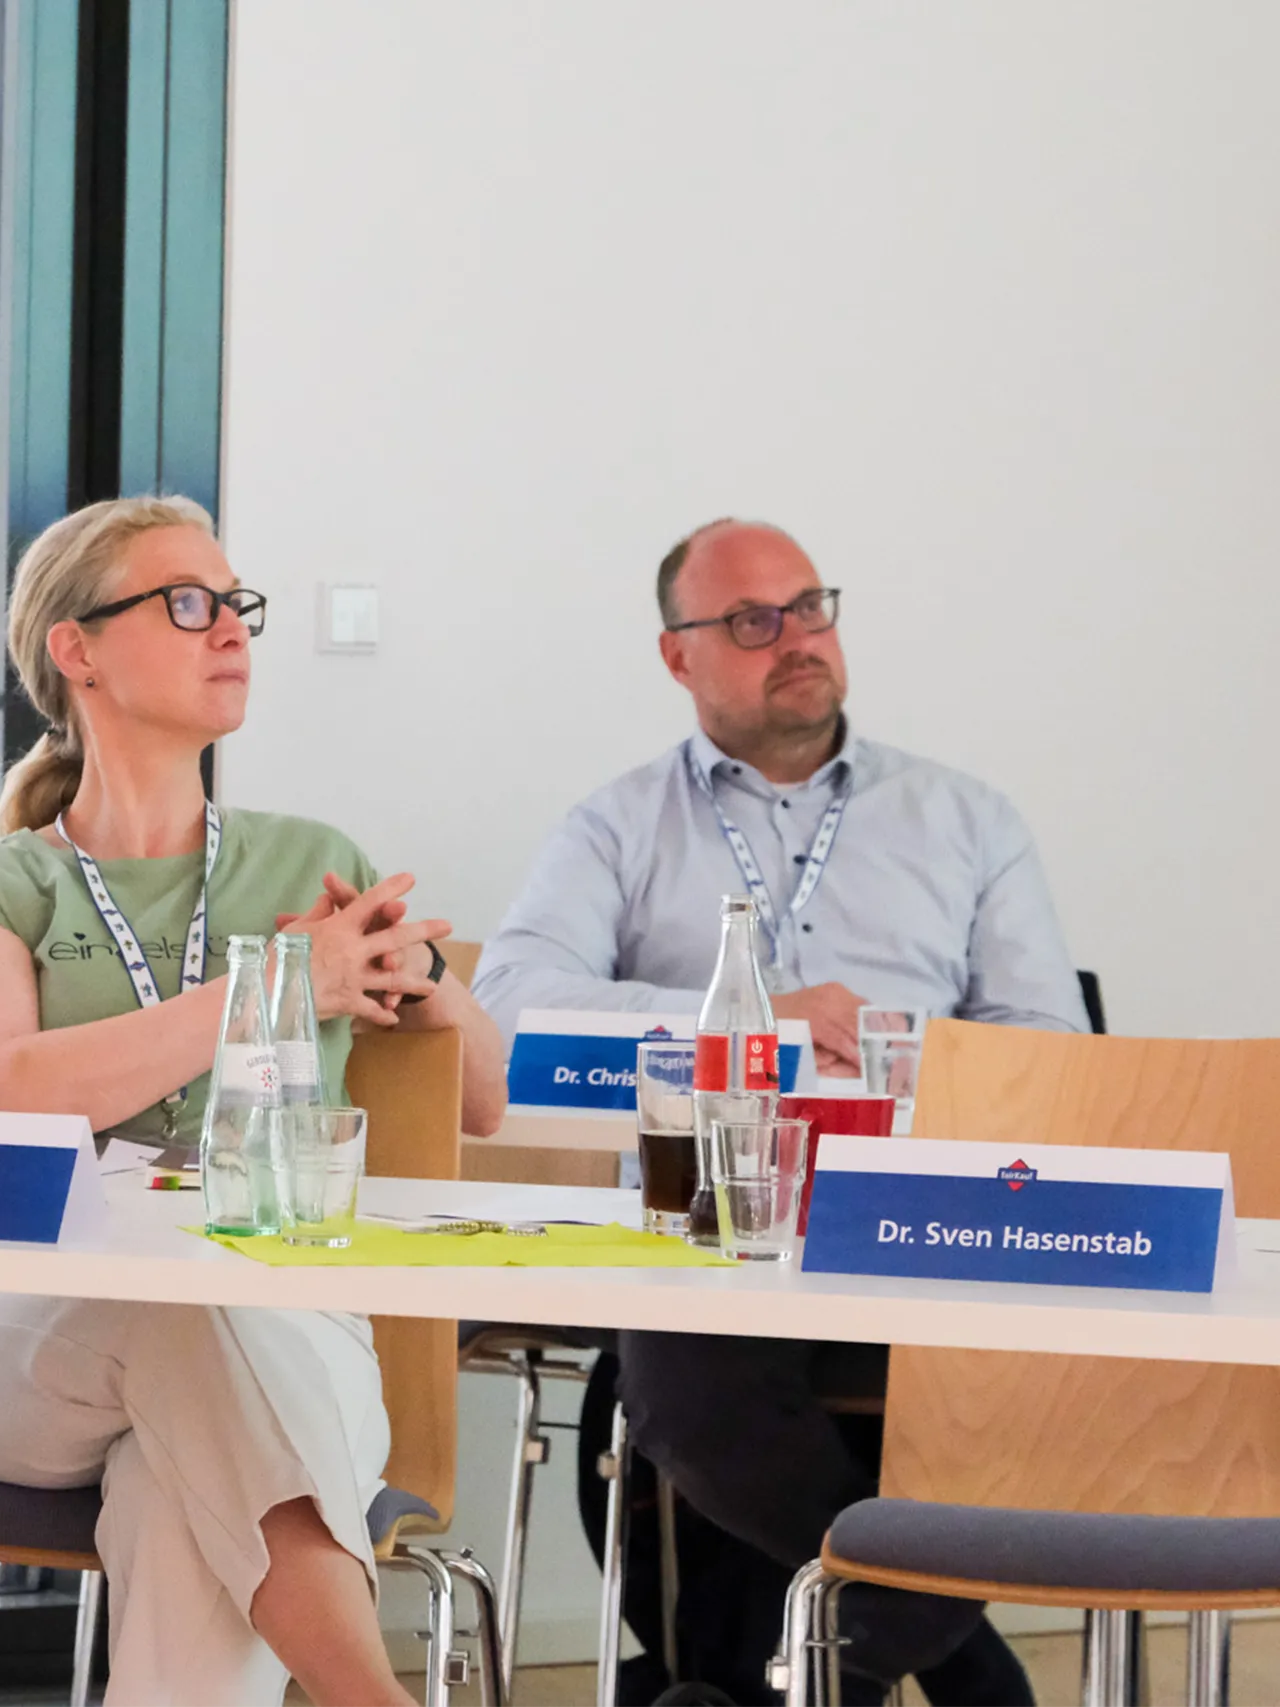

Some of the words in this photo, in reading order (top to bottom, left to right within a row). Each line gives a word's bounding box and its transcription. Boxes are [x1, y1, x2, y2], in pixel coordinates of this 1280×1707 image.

[553, 1066, 581, 1084] Dr.
[587, 1067, 637, 1087] Chris
[877, 1219, 915, 1244] Dr.
[924, 1221, 993, 1248] Sven
[1002, 1225, 1152, 1256] Hasenstab
